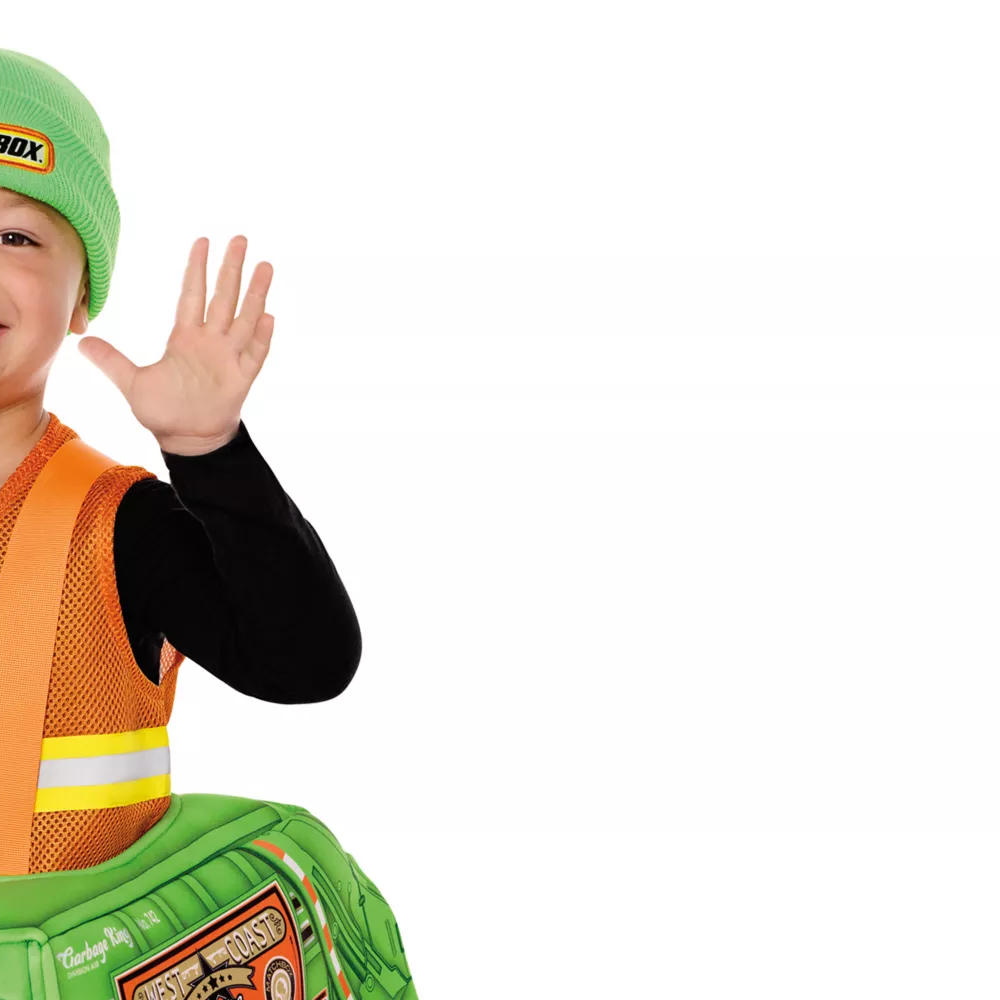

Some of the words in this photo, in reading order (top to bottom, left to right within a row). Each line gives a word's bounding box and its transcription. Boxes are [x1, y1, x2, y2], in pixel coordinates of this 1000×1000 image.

[57, 941, 108, 969] Garbage
[104, 927, 134, 948] King
[224, 912, 276, 964] COAST
